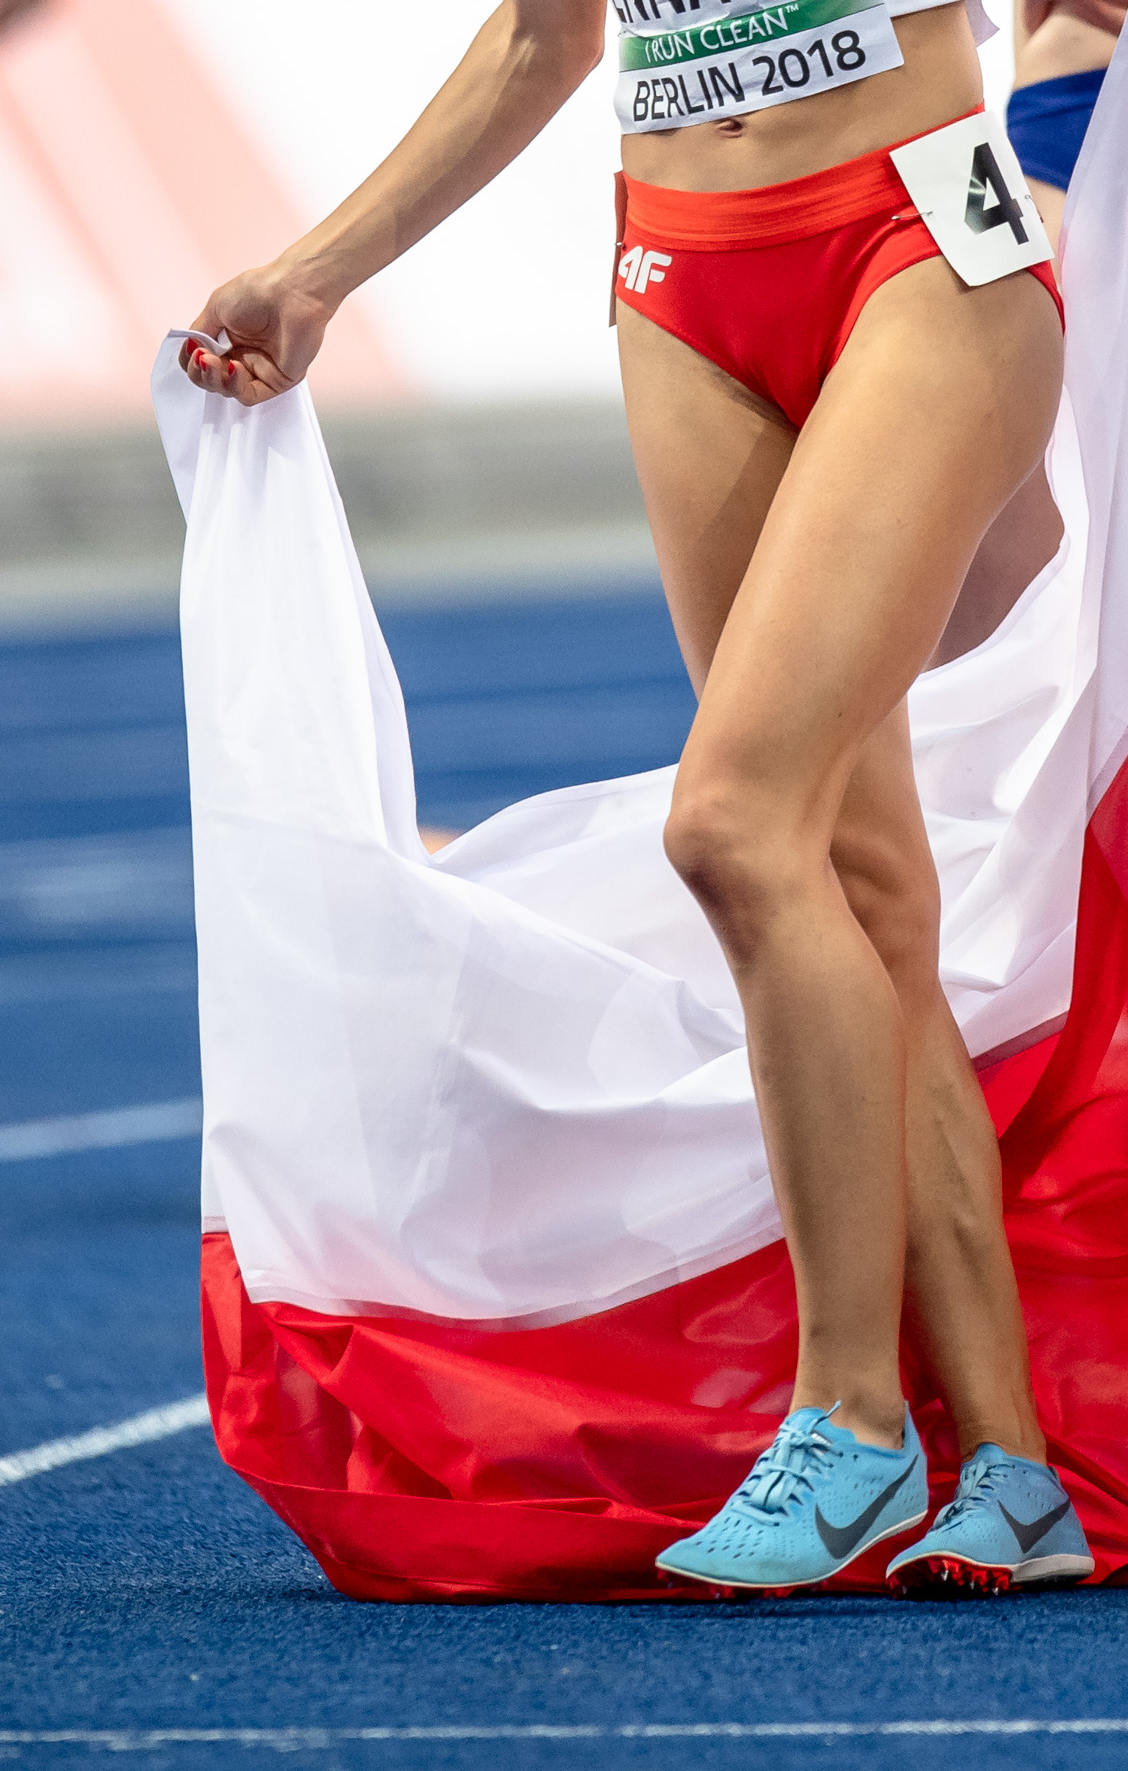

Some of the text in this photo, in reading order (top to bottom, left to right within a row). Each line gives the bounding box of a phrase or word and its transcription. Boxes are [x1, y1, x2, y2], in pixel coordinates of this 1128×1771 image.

[633, 30, 866, 122] BERLIN 2018
[651, 31, 695, 62] RUN
[963, 141, 1030, 246] 4
